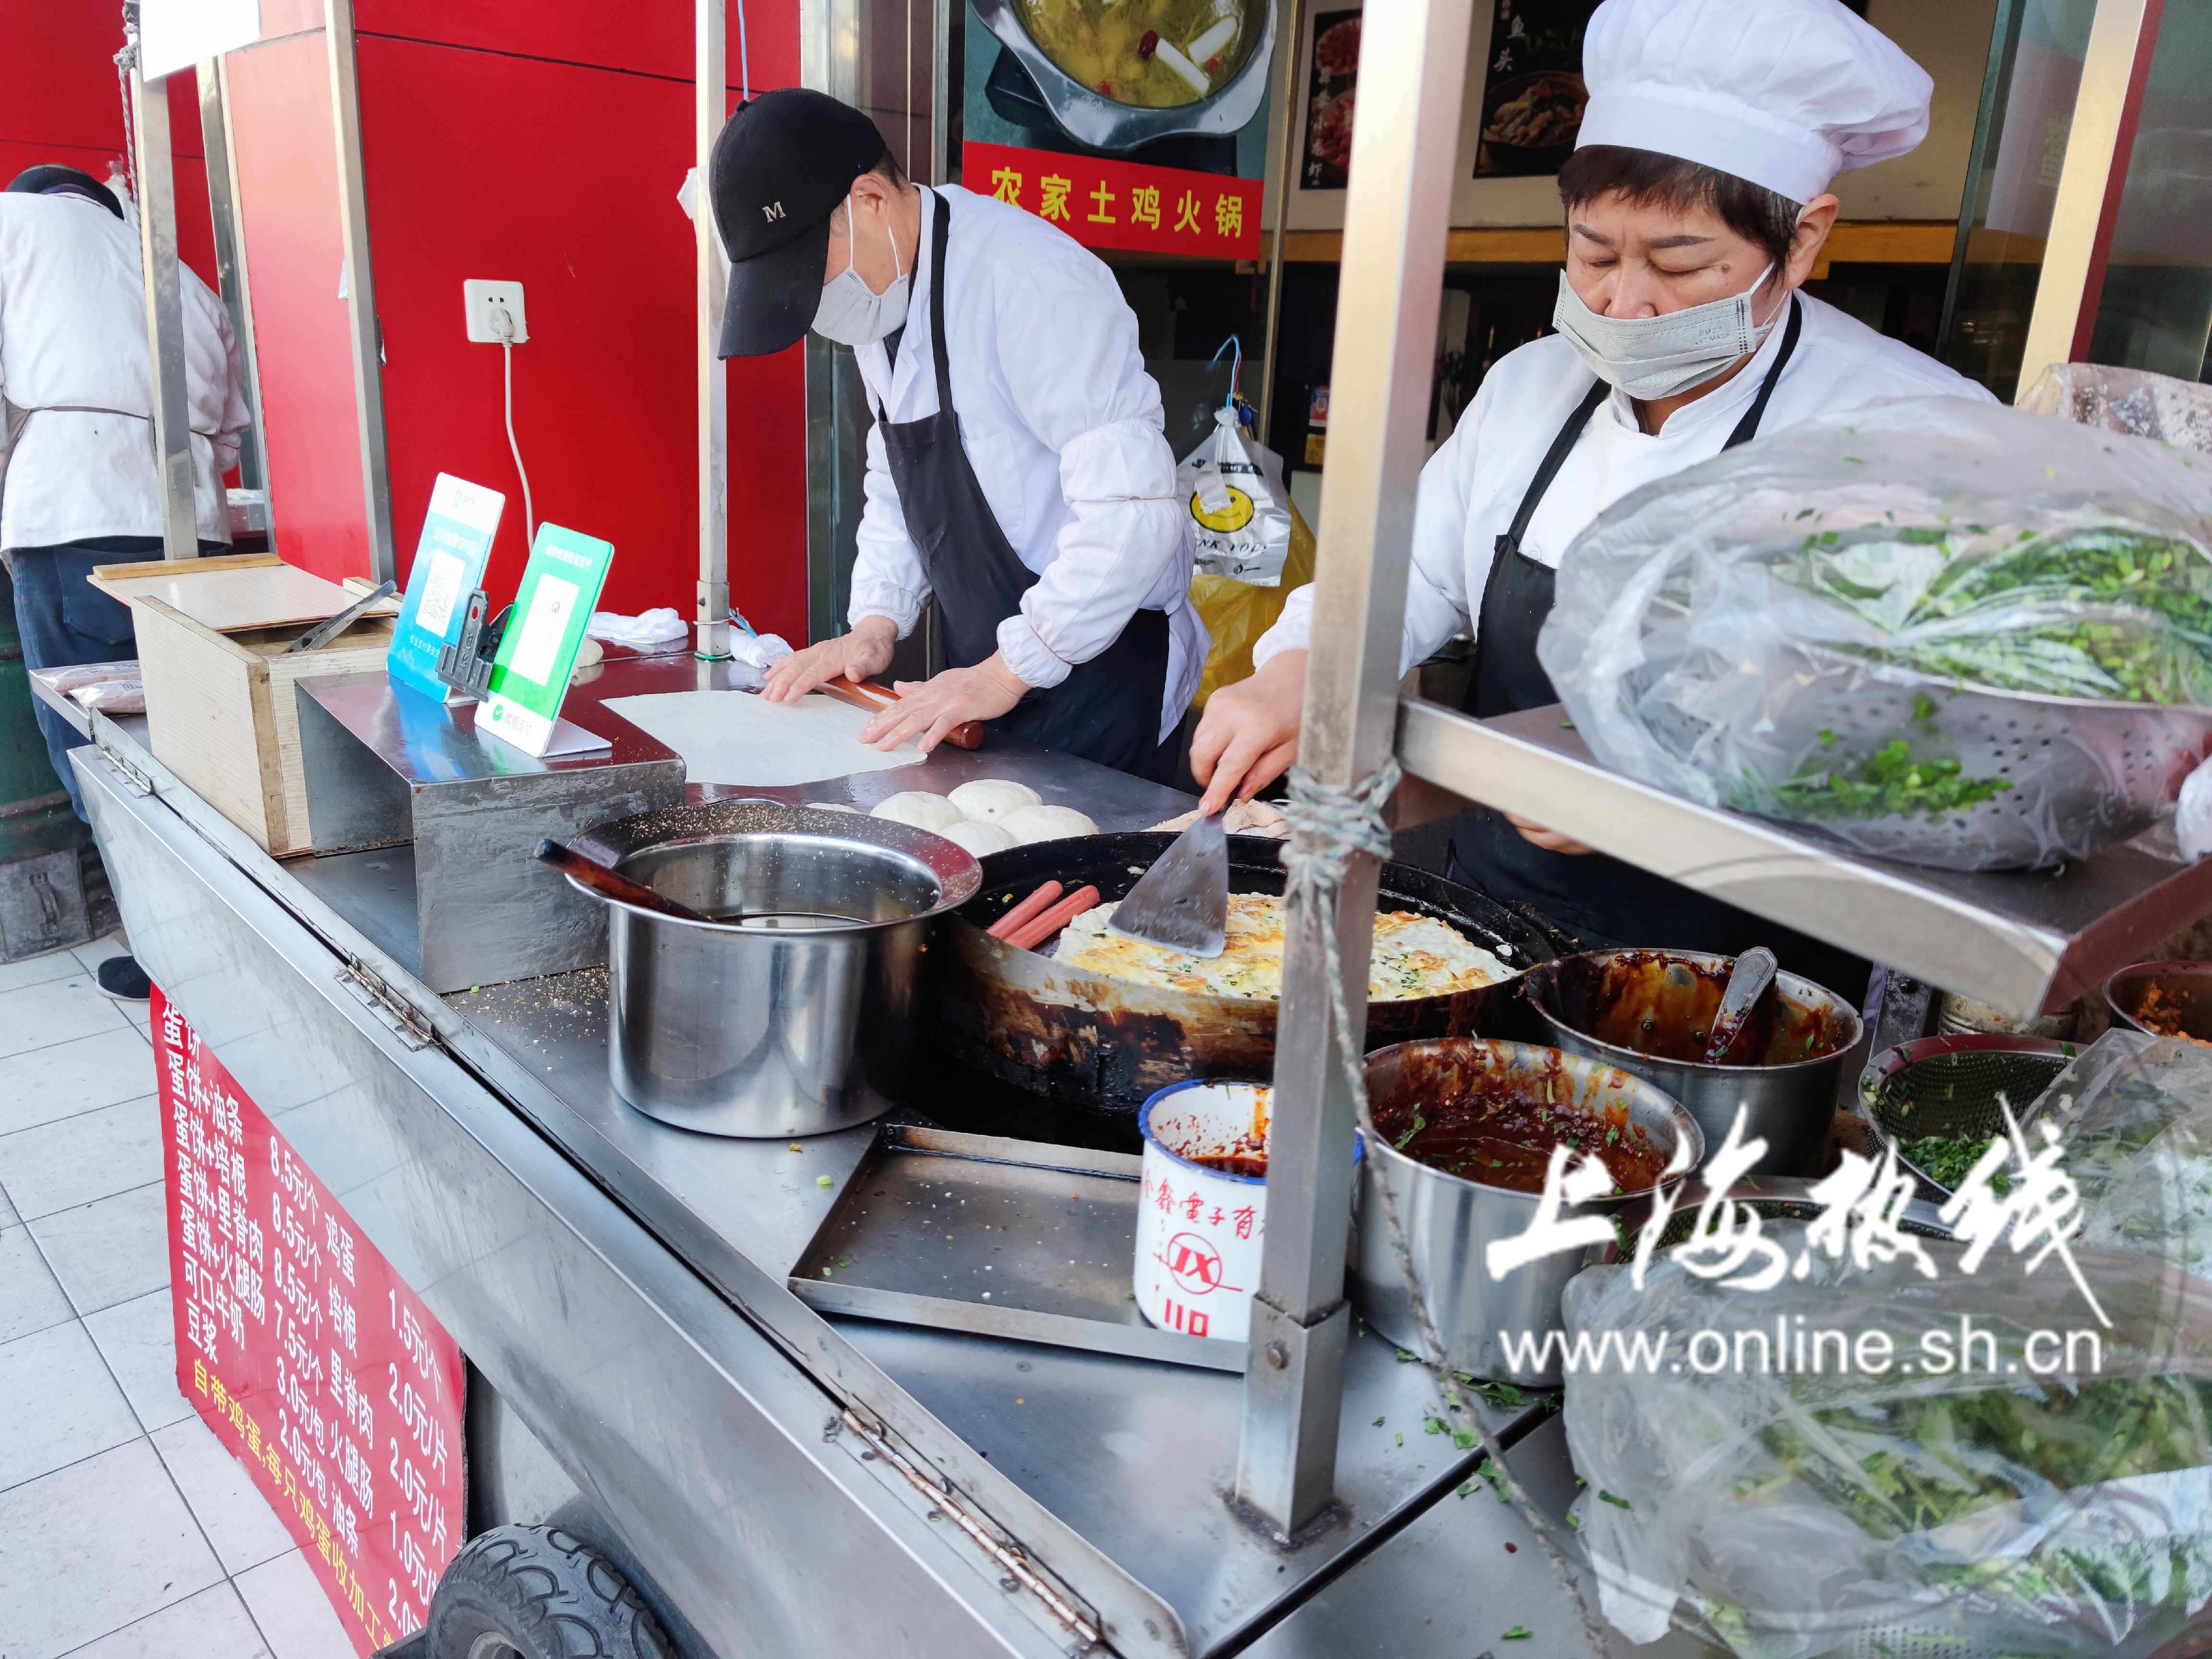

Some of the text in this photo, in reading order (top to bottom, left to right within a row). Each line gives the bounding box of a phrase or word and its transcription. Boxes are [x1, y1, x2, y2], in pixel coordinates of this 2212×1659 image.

[762, 201, 786, 222] M
[991, 167, 1242, 238] 农家土鸡火锅
[166, 1048, 442, 1402] 蛋饼+油条 8.5元/个 鸡蛋 1.5元/个
[173, 1098, 447, 1486] 蛋饼+培根 8.5元/个 培根 2.0元/片
[177, 1149, 447, 1563] 蛋饼+里脊肉 8.5元/个 里脊肉 2.0元/片
[180, 1199, 264, 1325] 蛋饼+火腿肠
[275, 1300, 323, 1396] 7.5元/个
[330, 1419, 373, 1519] 火腿肠
[1165, 1298, 1209, 1338] 110
[183, 1250, 245, 1351] 可口牛奶
[277, 1356, 325, 1456] 3.0元/包
[332, 1481, 358, 1559] 油条
[186, 1297, 326, 1509] 豆浆 2.0元/包
